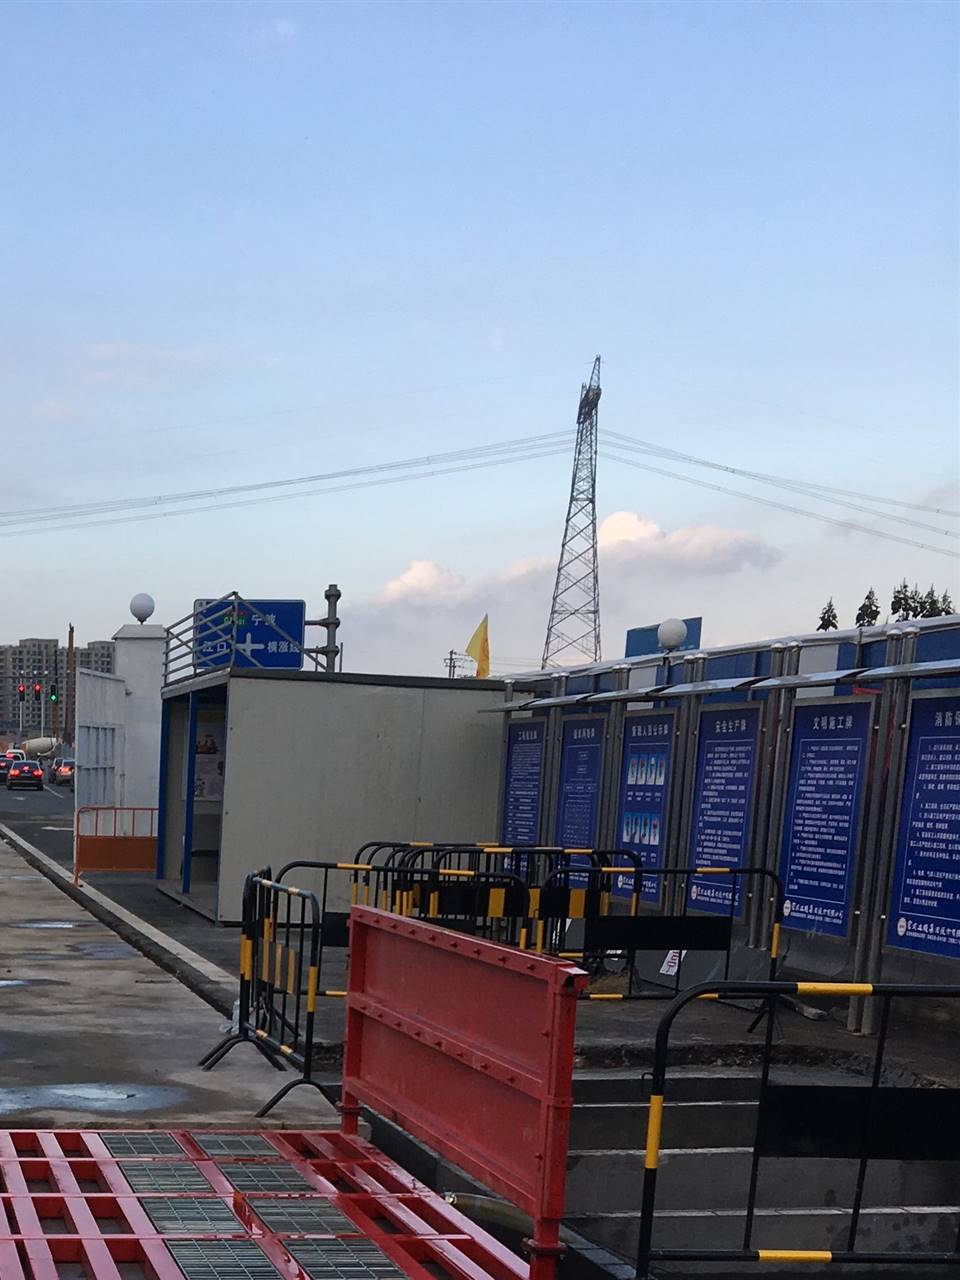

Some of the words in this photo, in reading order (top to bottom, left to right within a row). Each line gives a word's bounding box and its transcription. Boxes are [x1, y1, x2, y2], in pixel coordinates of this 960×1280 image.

[251, 614, 277, 626] 宁波
[202, 641, 227, 652] 江口
[715, 719, 746, 733] 安全生产牌
[813, 715, 853, 730] 文明施工牌
